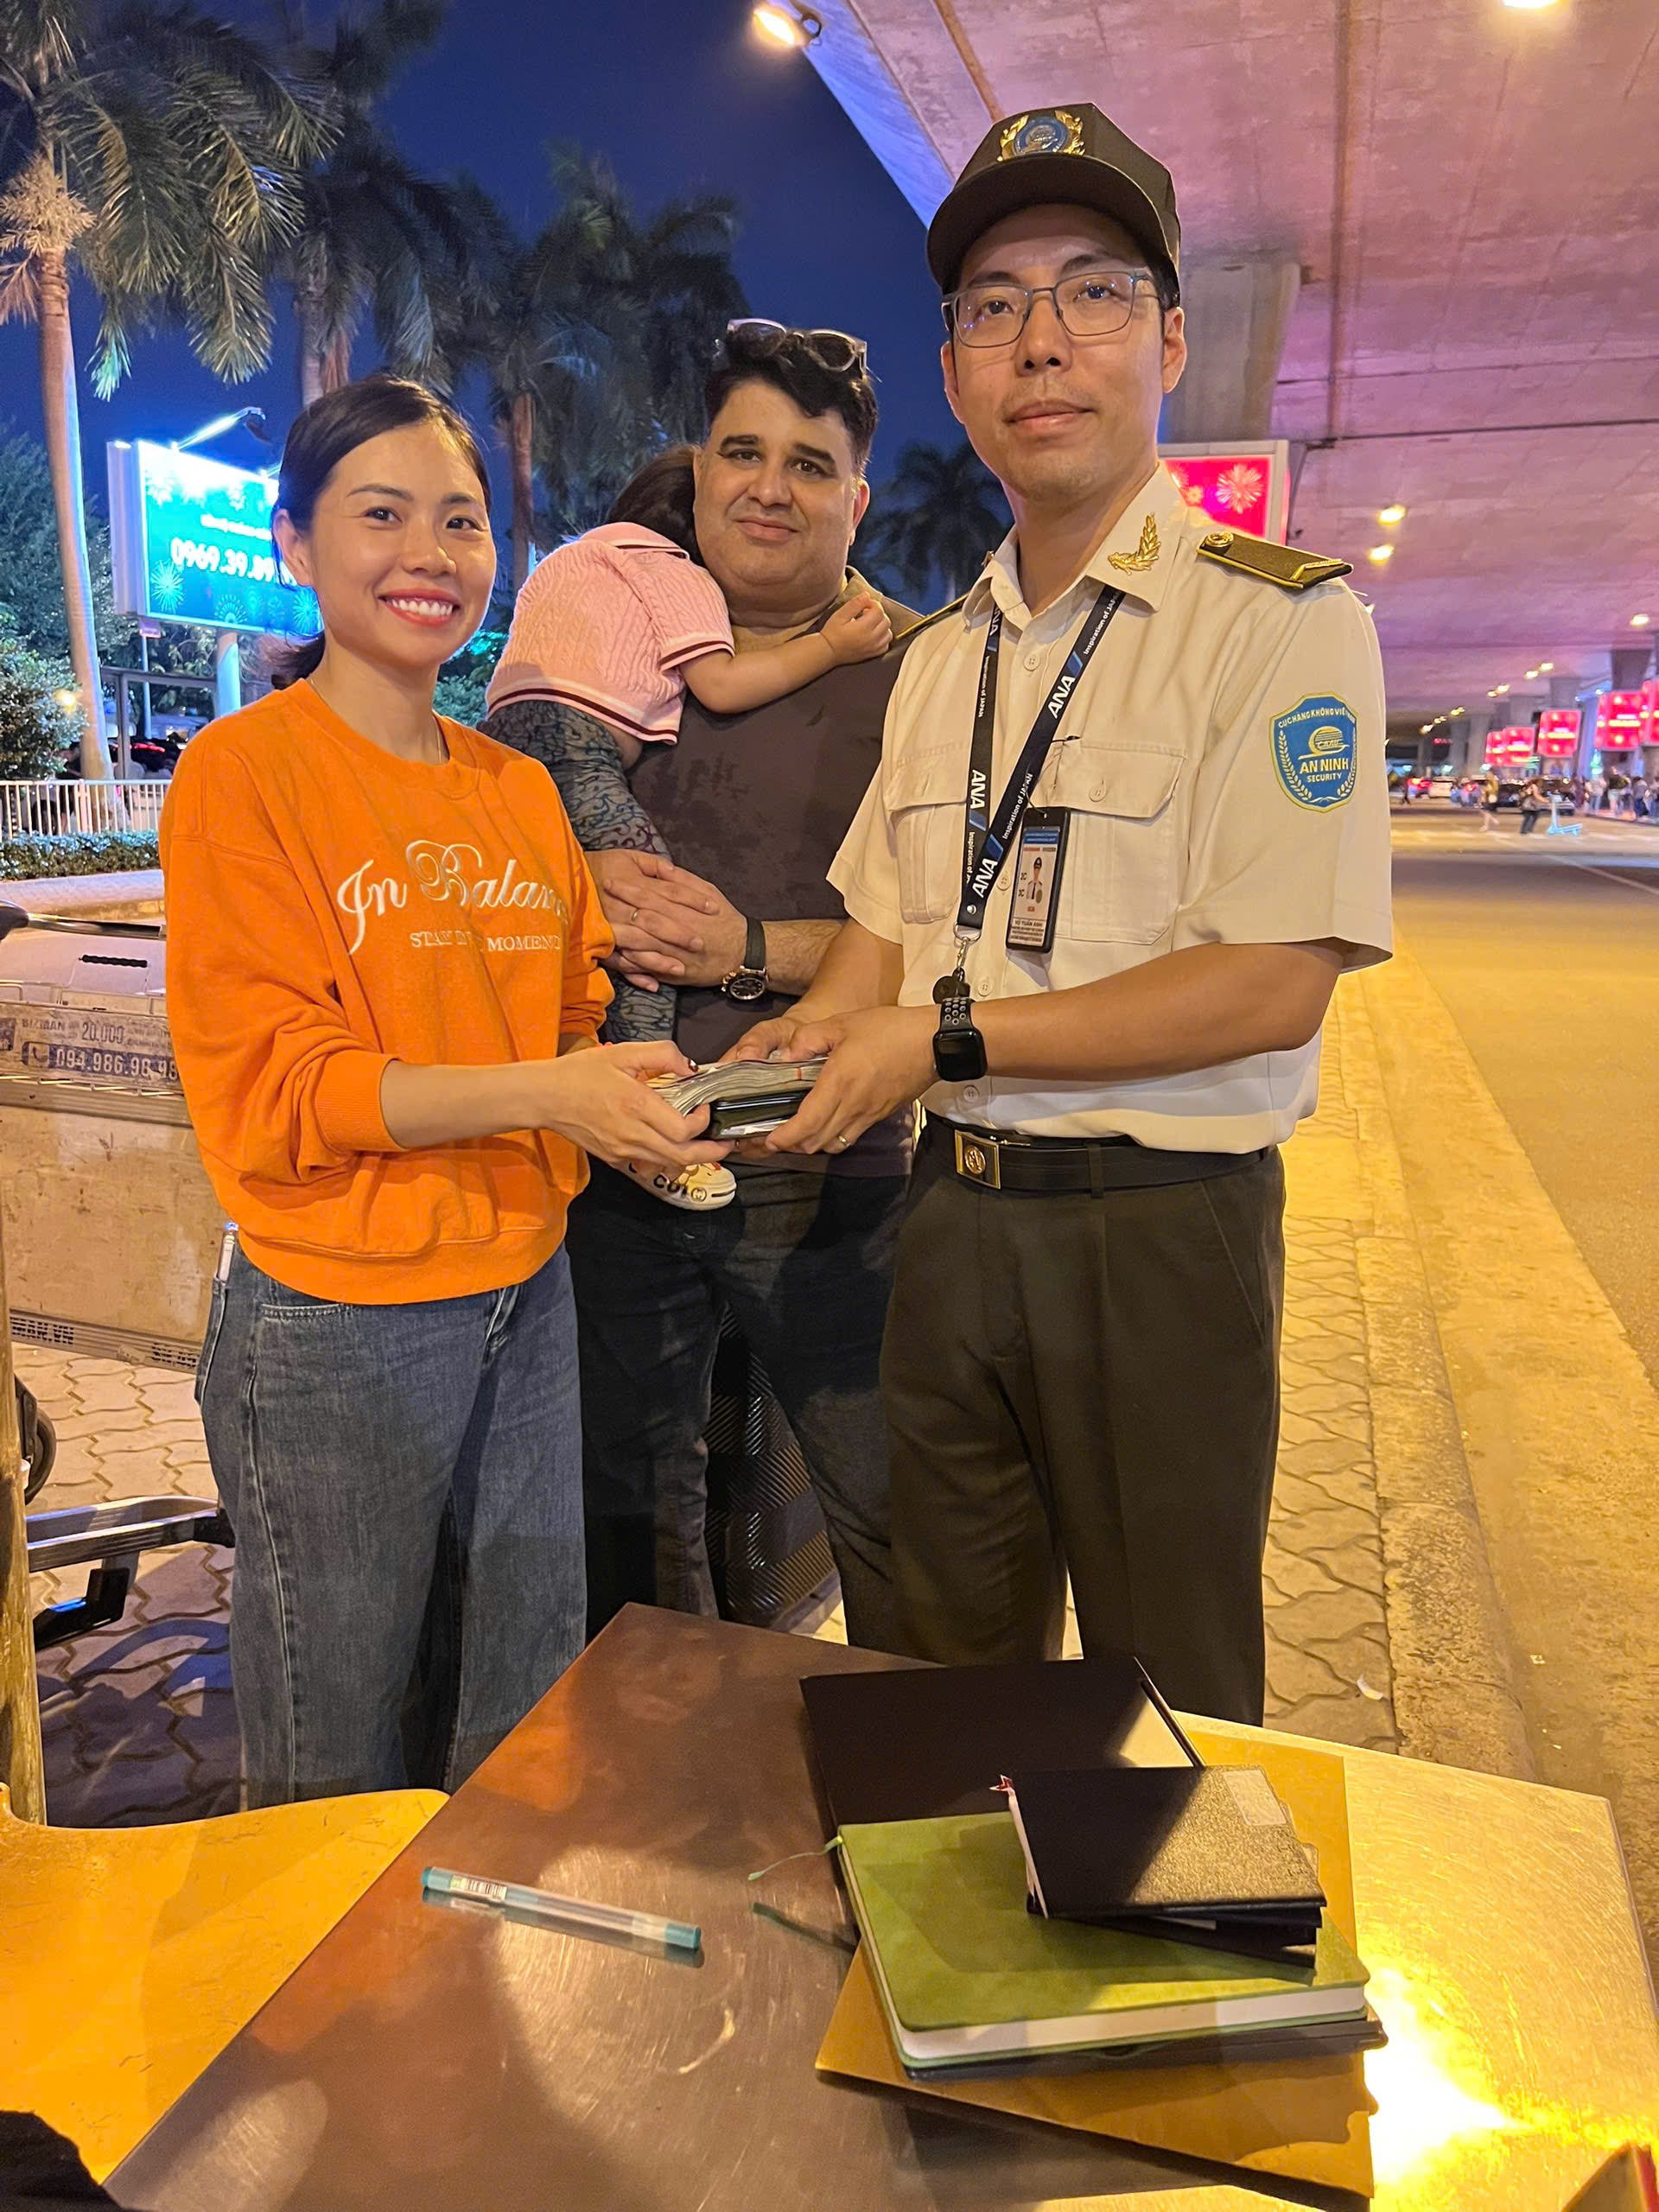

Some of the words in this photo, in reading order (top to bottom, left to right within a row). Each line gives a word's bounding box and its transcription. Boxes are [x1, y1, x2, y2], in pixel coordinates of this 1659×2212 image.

[1083, 619, 1106, 655] Inspiration
[1047, 675, 1076, 719] ANA
[1300, 760, 1318, 774] AN
[1320, 757, 1349, 772] NINH
[1306, 772, 1342, 783] SECURITY
[969, 769, 986, 810] ANA
[1001, 804, 1021, 840] Inspiration
[967, 831, 976, 866] Inspiration
[972, 858, 998, 899] ANA
